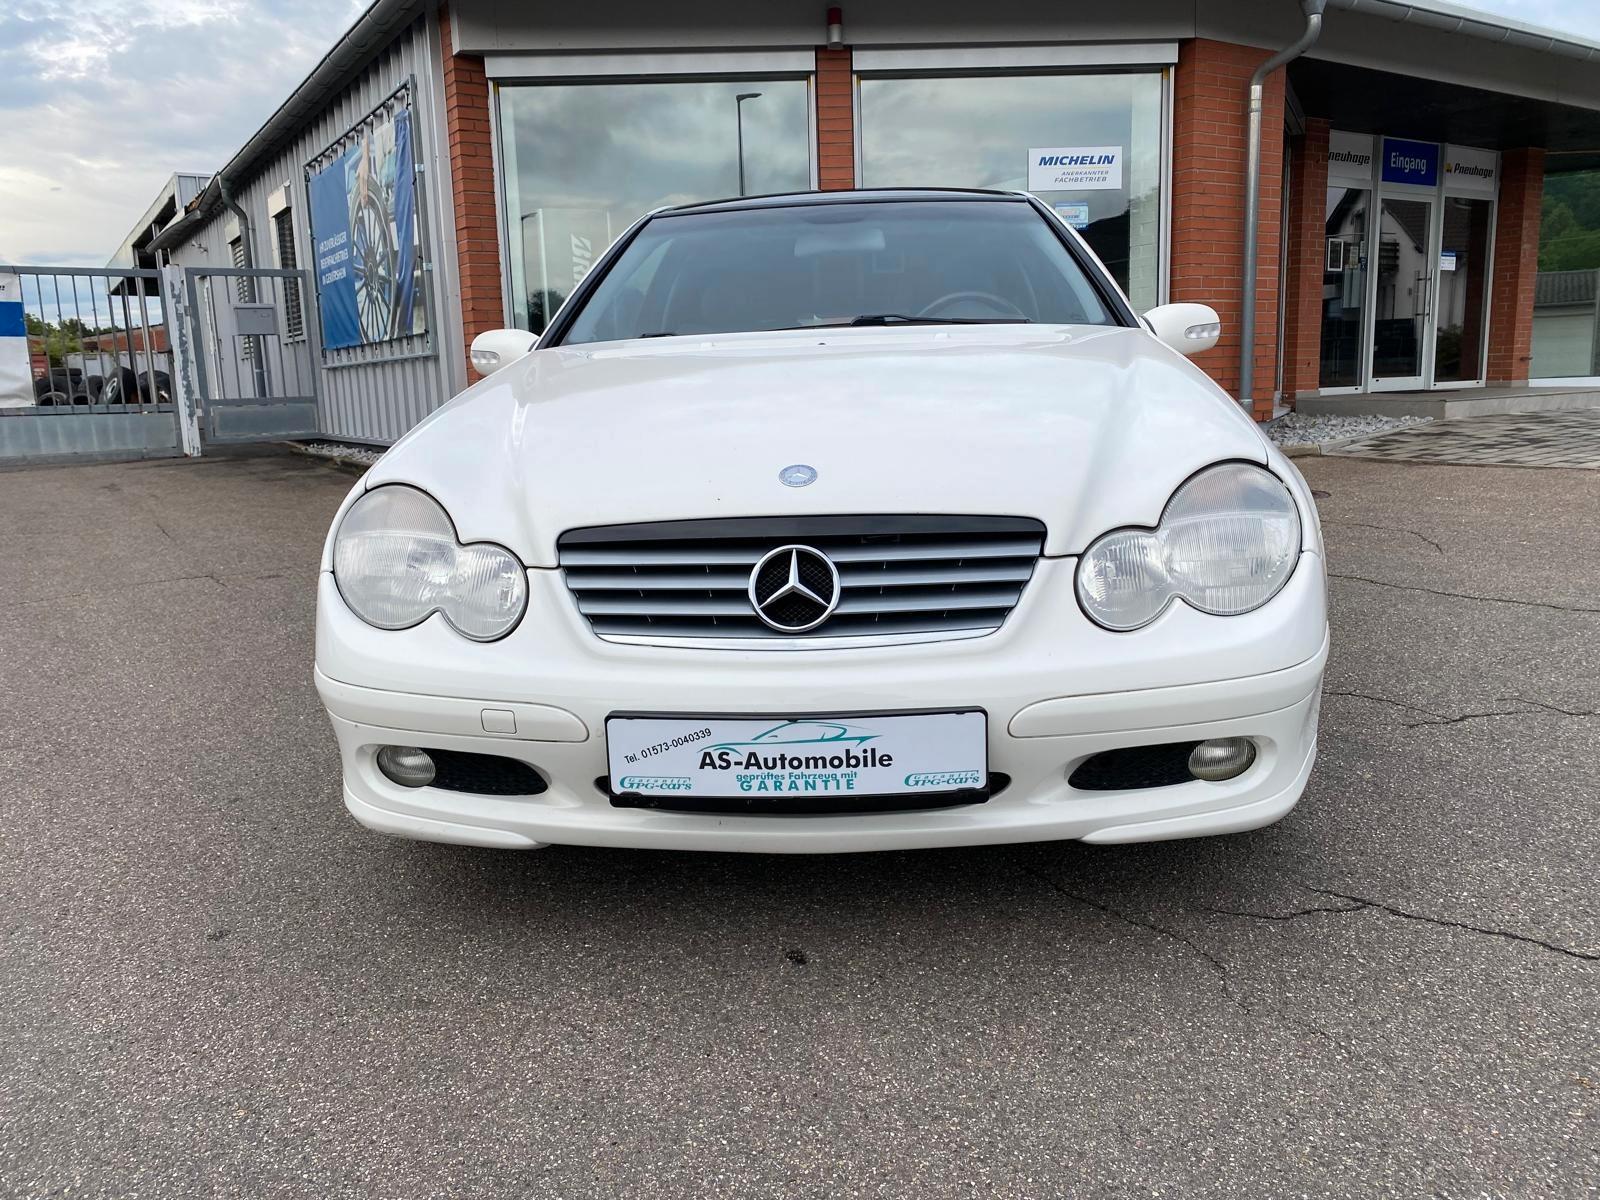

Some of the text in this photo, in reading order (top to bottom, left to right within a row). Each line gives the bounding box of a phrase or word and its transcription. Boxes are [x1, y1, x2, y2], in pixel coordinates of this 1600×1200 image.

[1038, 155, 1115, 166] MICHELIN
[1328, 150, 1370, 166] neuhage
[1391, 152, 1427, 174] Eingang
[1454, 163, 1494, 178] Pneuhage
[1054, 176, 1108, 184] FACHBETRIEB
[624, 728, 712, 764] Tel. 01573-0040339
[699, 748, 894, 770] AS-Automobile
[736, 770, 857, 782] geprüftes Fahrzeug mit
[739, 779, 855, 792] GARANTIE
